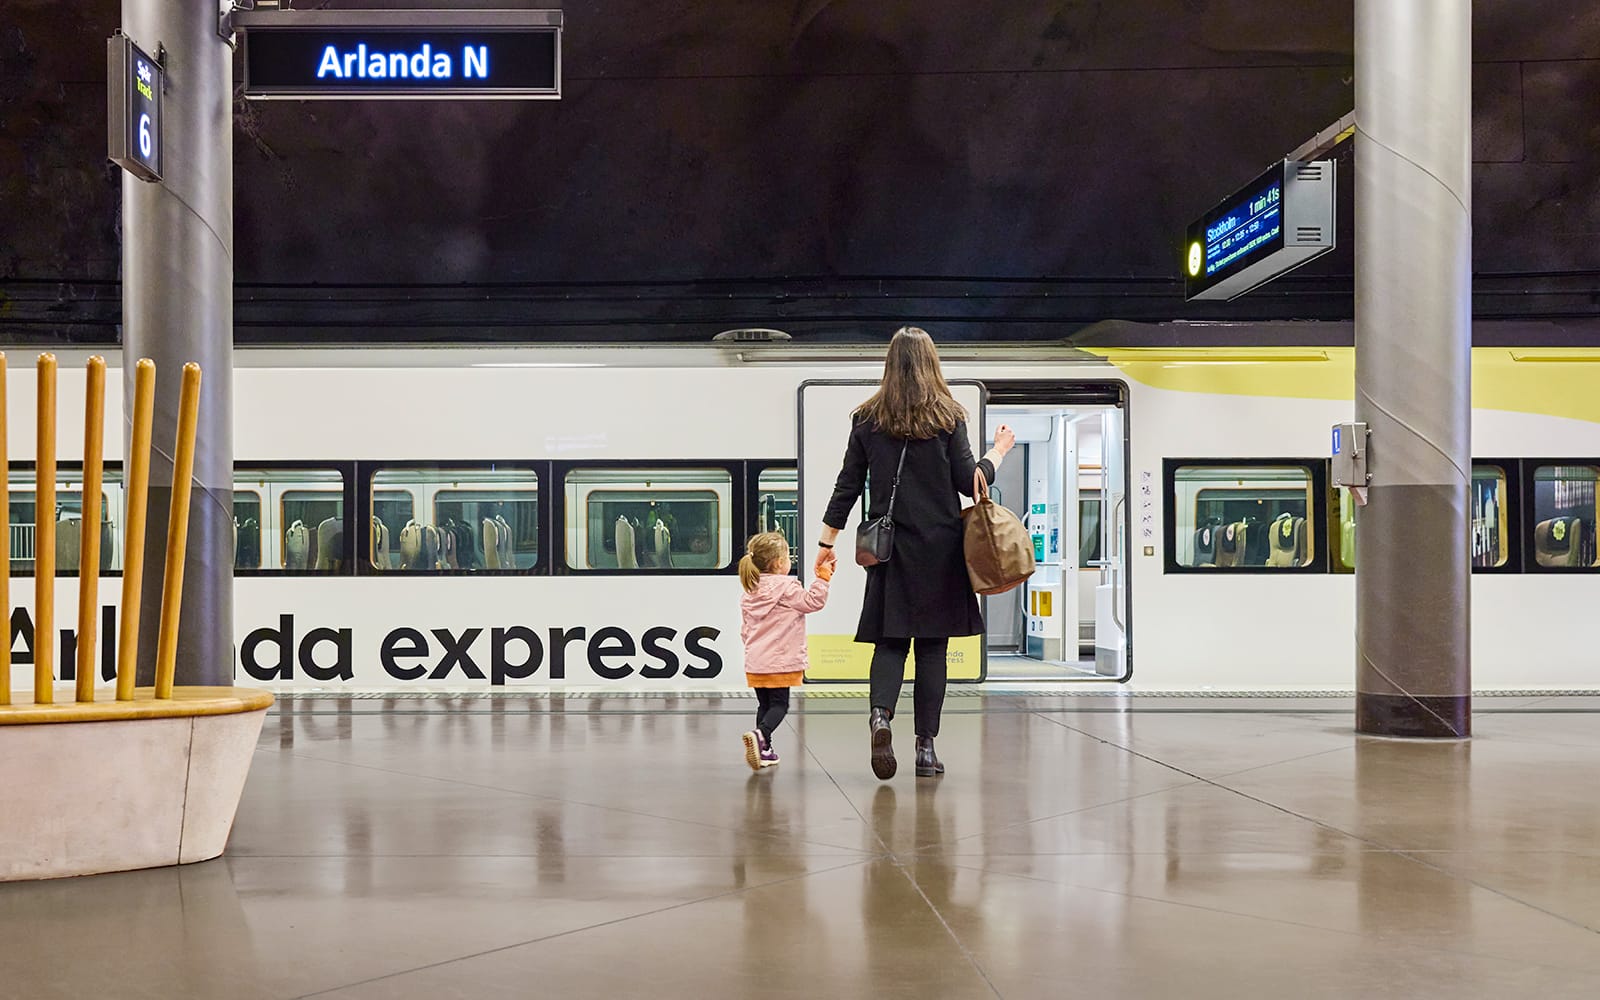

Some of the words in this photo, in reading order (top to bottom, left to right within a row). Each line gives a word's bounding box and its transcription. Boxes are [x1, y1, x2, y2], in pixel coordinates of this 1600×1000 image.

[317, 43, 451, 78] Arlanda
[464, 46, 488, 78] N
[136, 76, 153, 101] Track
[139, 113, 151, 158] 6
[1249, 202, 1254, 216] 1
[1254, 195, 1267, 213] min
[380, 626, 723, 686] express
